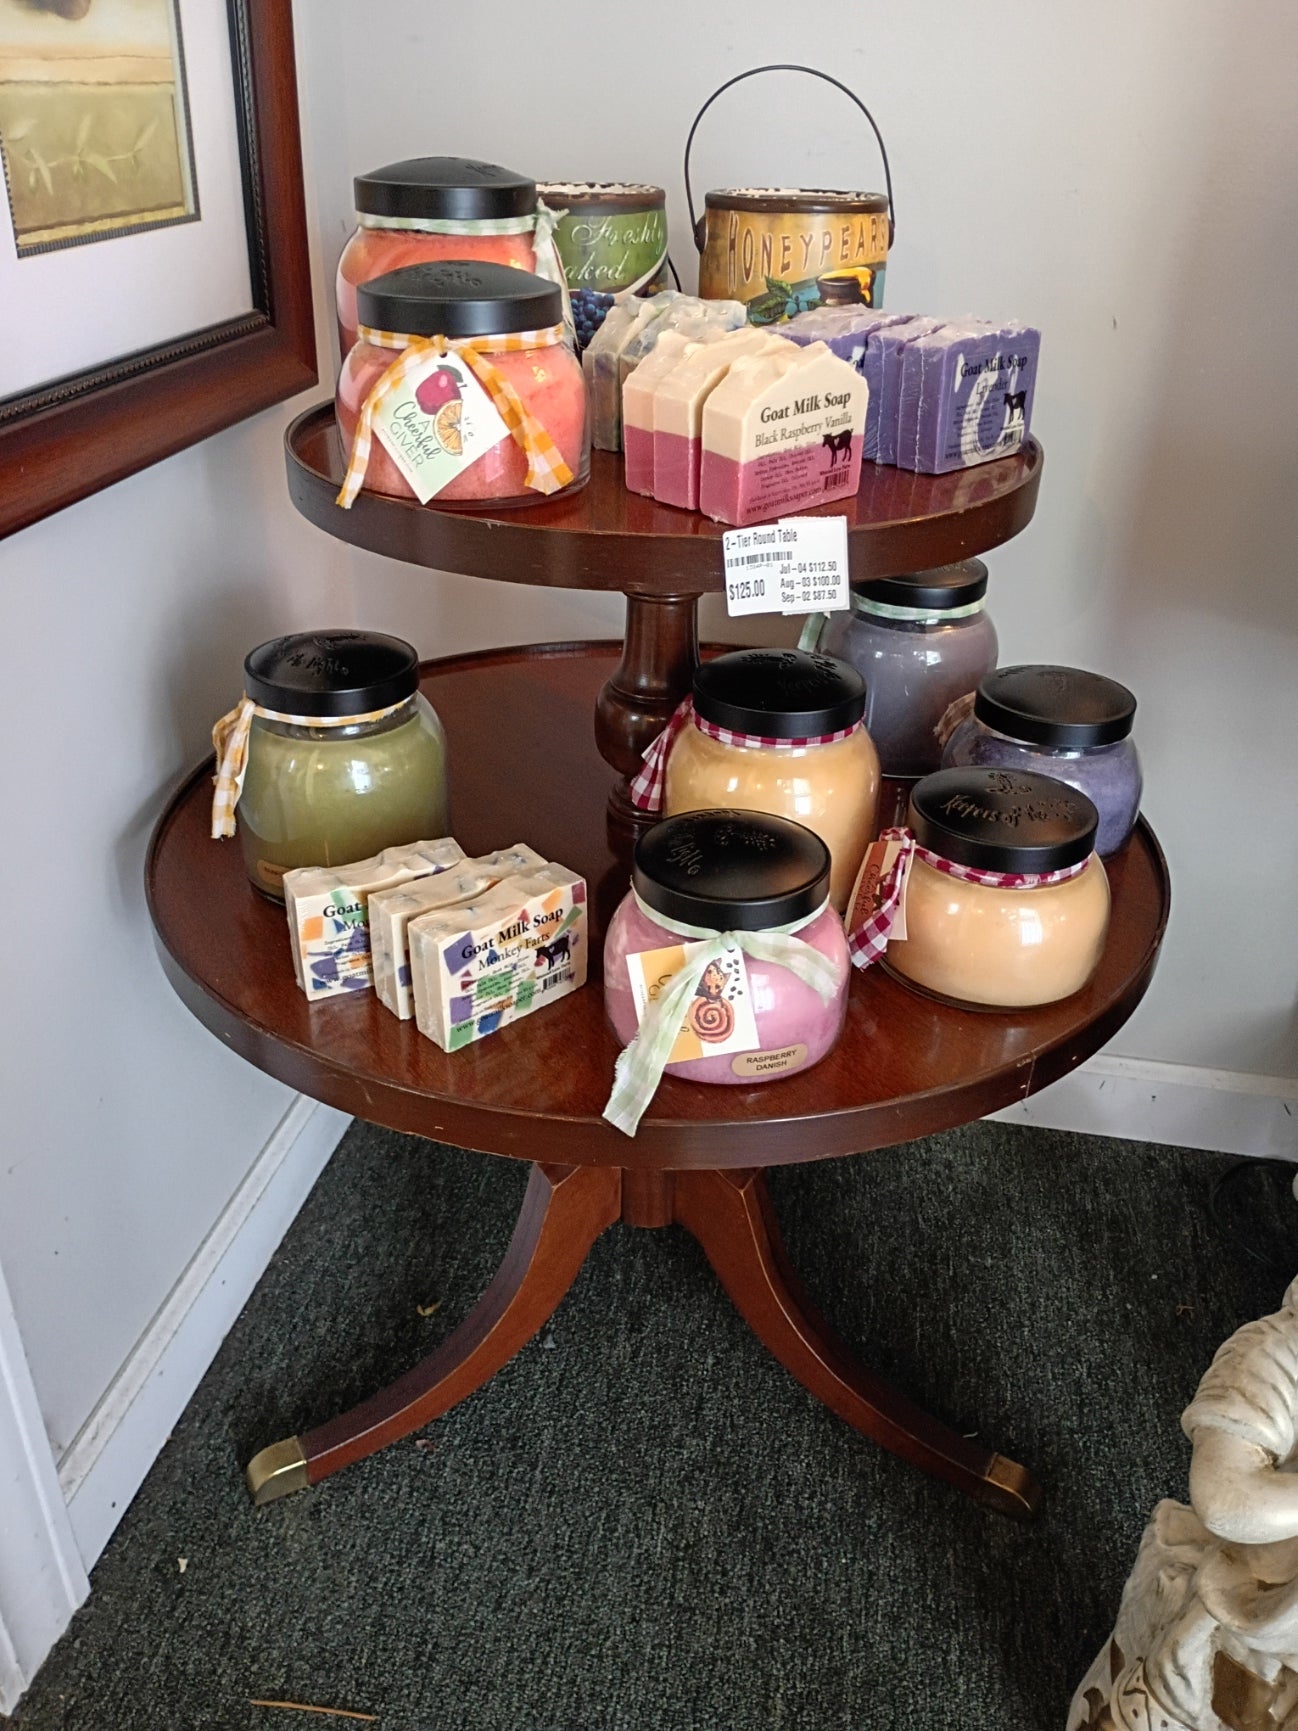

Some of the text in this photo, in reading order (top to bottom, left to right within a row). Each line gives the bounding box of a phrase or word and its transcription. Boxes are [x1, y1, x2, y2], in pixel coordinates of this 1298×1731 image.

[571, 213, 664, 255] Freshly
[727, 210, 887, 295] HONEYPEARS
[564, 250, 625, 280] aked
[960, 354, 1028, 378] Goat Milk Soap
[760, 391, 852, 423] Goat Milk Soap
[392, 400, 442, 460] Cheerful
[418, 420, 431, 433] A
[754, 411, 853, 447] Black Raspberry Vanilla
[389, 421, 424, 468] GIVER
[753, 530, 776, 545] Round
[777, 528, 798, 543] Table
[808, 561, 837, 573] $112.50
[728, 579, 766, 601] $125.00
[812, 575, 841, 587] $100.00
[812, 589, 837, 601] $87.50
[323, 902, 362, 918] Goat
[461, 908, 563, 960] Goat Milk Soap
[478, 944, 523, 971] Monkey
[524, 932, 551, 950] Farts
[746, 1049, 798, 1064] RASPBERRY
[756, 1060, 788, 1071] DANISH
